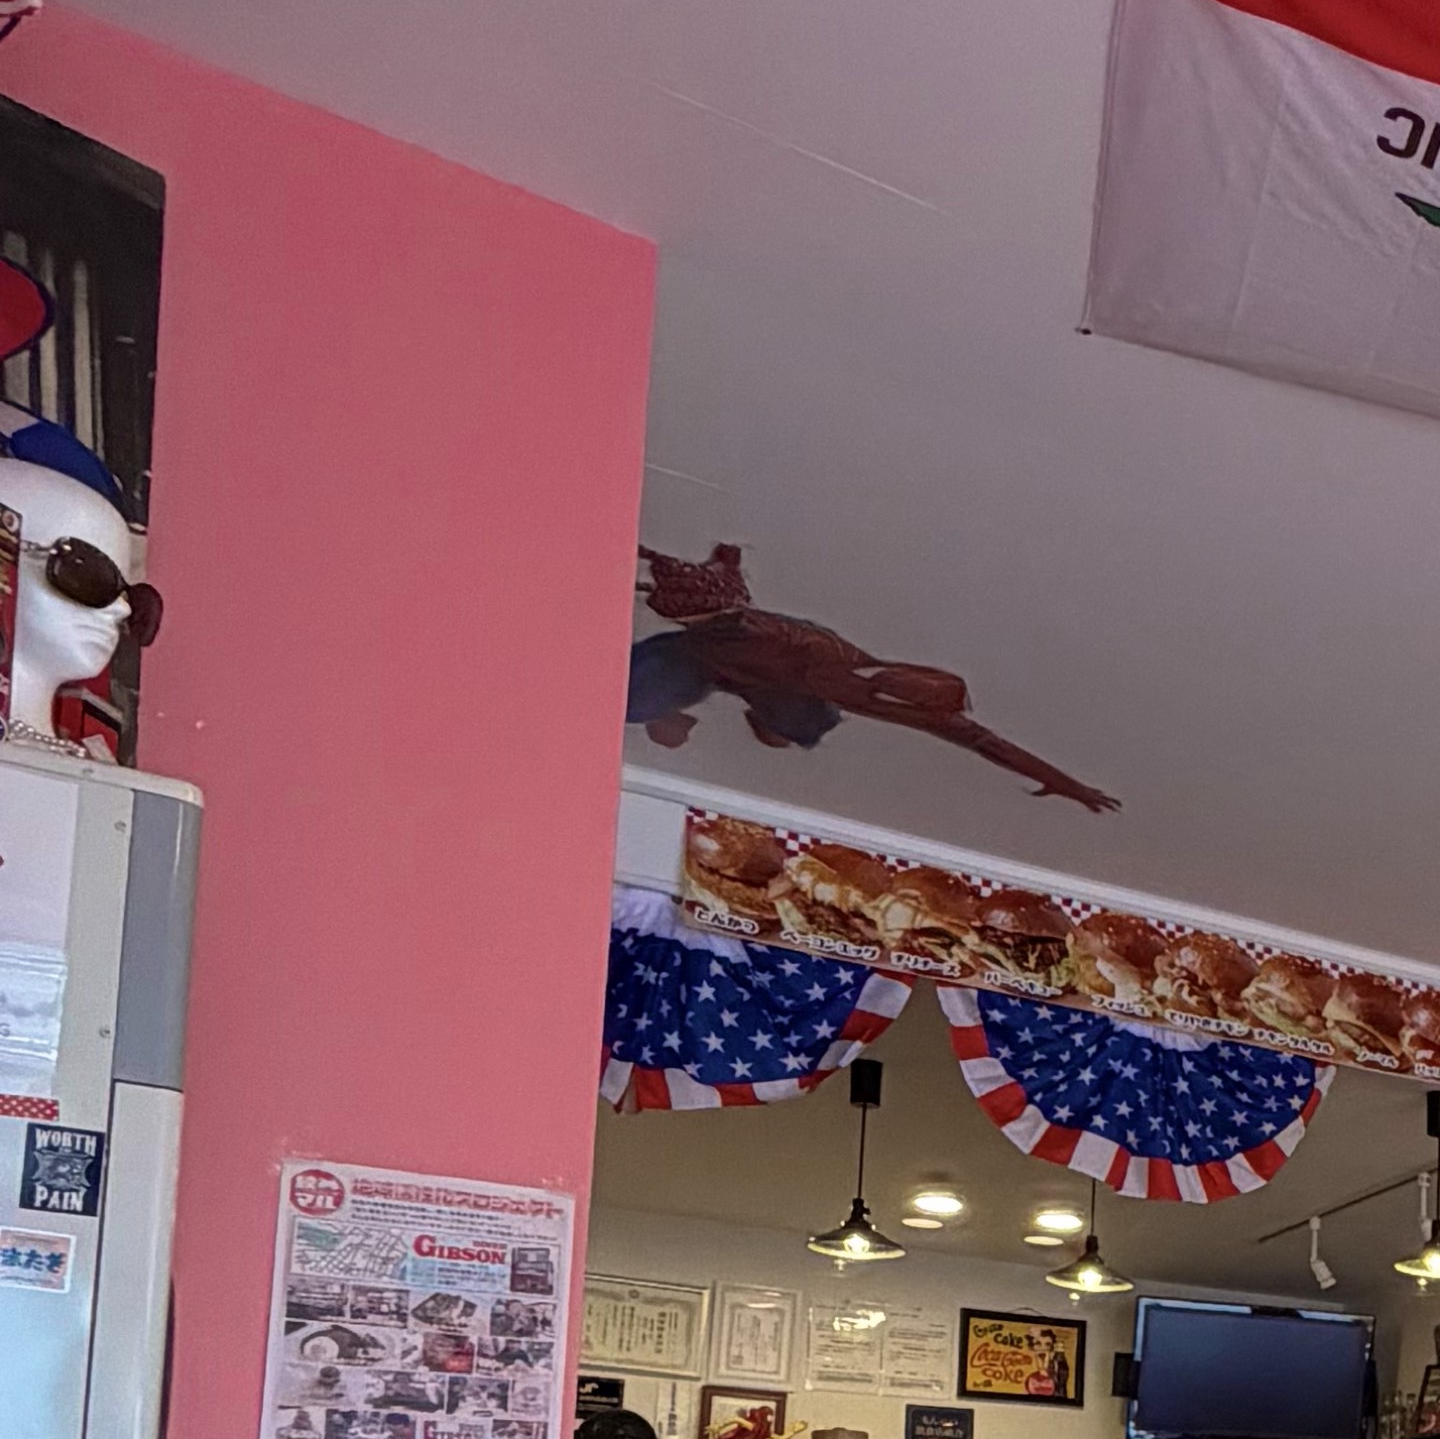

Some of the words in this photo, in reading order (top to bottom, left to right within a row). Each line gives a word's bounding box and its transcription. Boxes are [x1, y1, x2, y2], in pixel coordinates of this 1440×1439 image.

[34, 1126, 98, 1156] WORTH
[32, 1183, 85, 1215] PAIN
[412, 1233, 507, 1265] GIBSON
